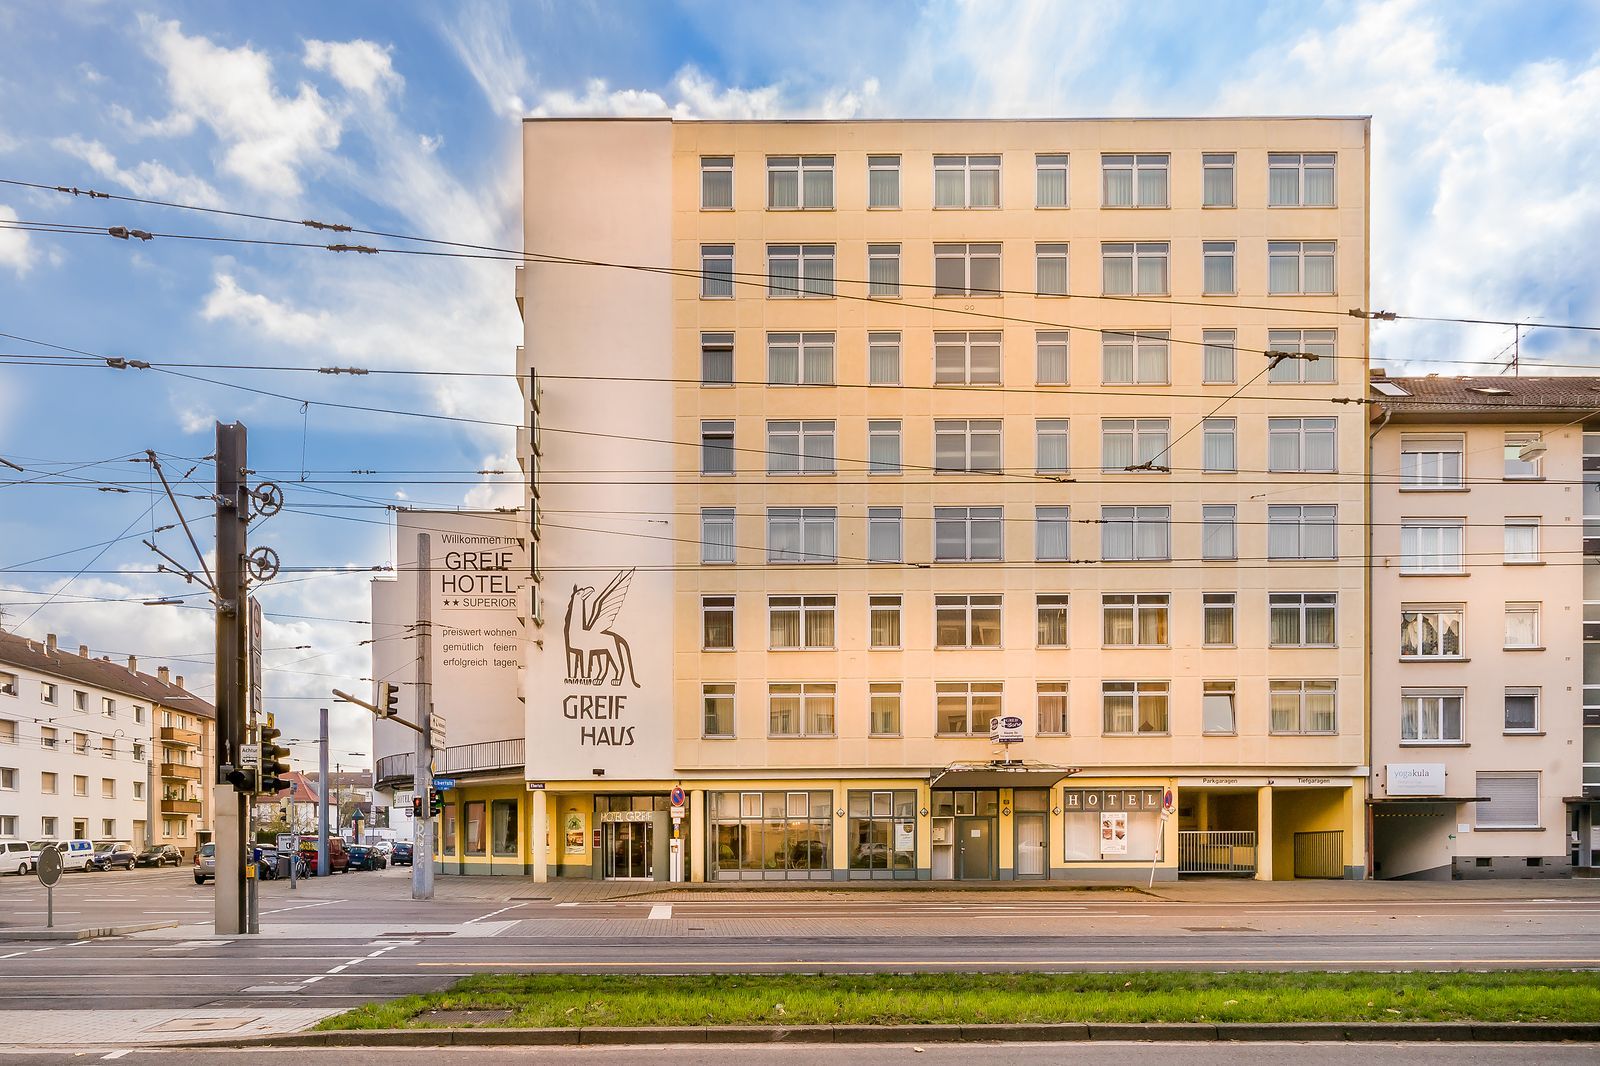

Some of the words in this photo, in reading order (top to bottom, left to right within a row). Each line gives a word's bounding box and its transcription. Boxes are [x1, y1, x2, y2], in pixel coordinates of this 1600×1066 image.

[441, 534, 501, 545] Willkommen
[504, 535, 516, 545] im
[445, 551, 513, 571] GREIF
[442, 574, 517, 594] HOTEL
[463, 597, 517, 608] SUPERIOR
[442, 628, 482, 638] preiswert
[483, 628, 518, 637] wohnen
[442, 642, 485, 653] gemütlich
[493, 642, 518, 652] feiern
[443, 657, 489, 669] erfolgreich
[493, 658, 518, 669] tagen
[562, 694, 628, 720] GREIF
[580, 726, 636, 746] HAUS
[1393, 769, 1430, 779] yogakula
[1202, 777, 1238, 785] Parkgaragen
[1297, 777, 1331, 785] Tiefgaragen
[1068, 794, 1156, 806] HOTEL
[600, 811, 624, 822] HOTEL
[625, 811, 653, 822] GREIF
